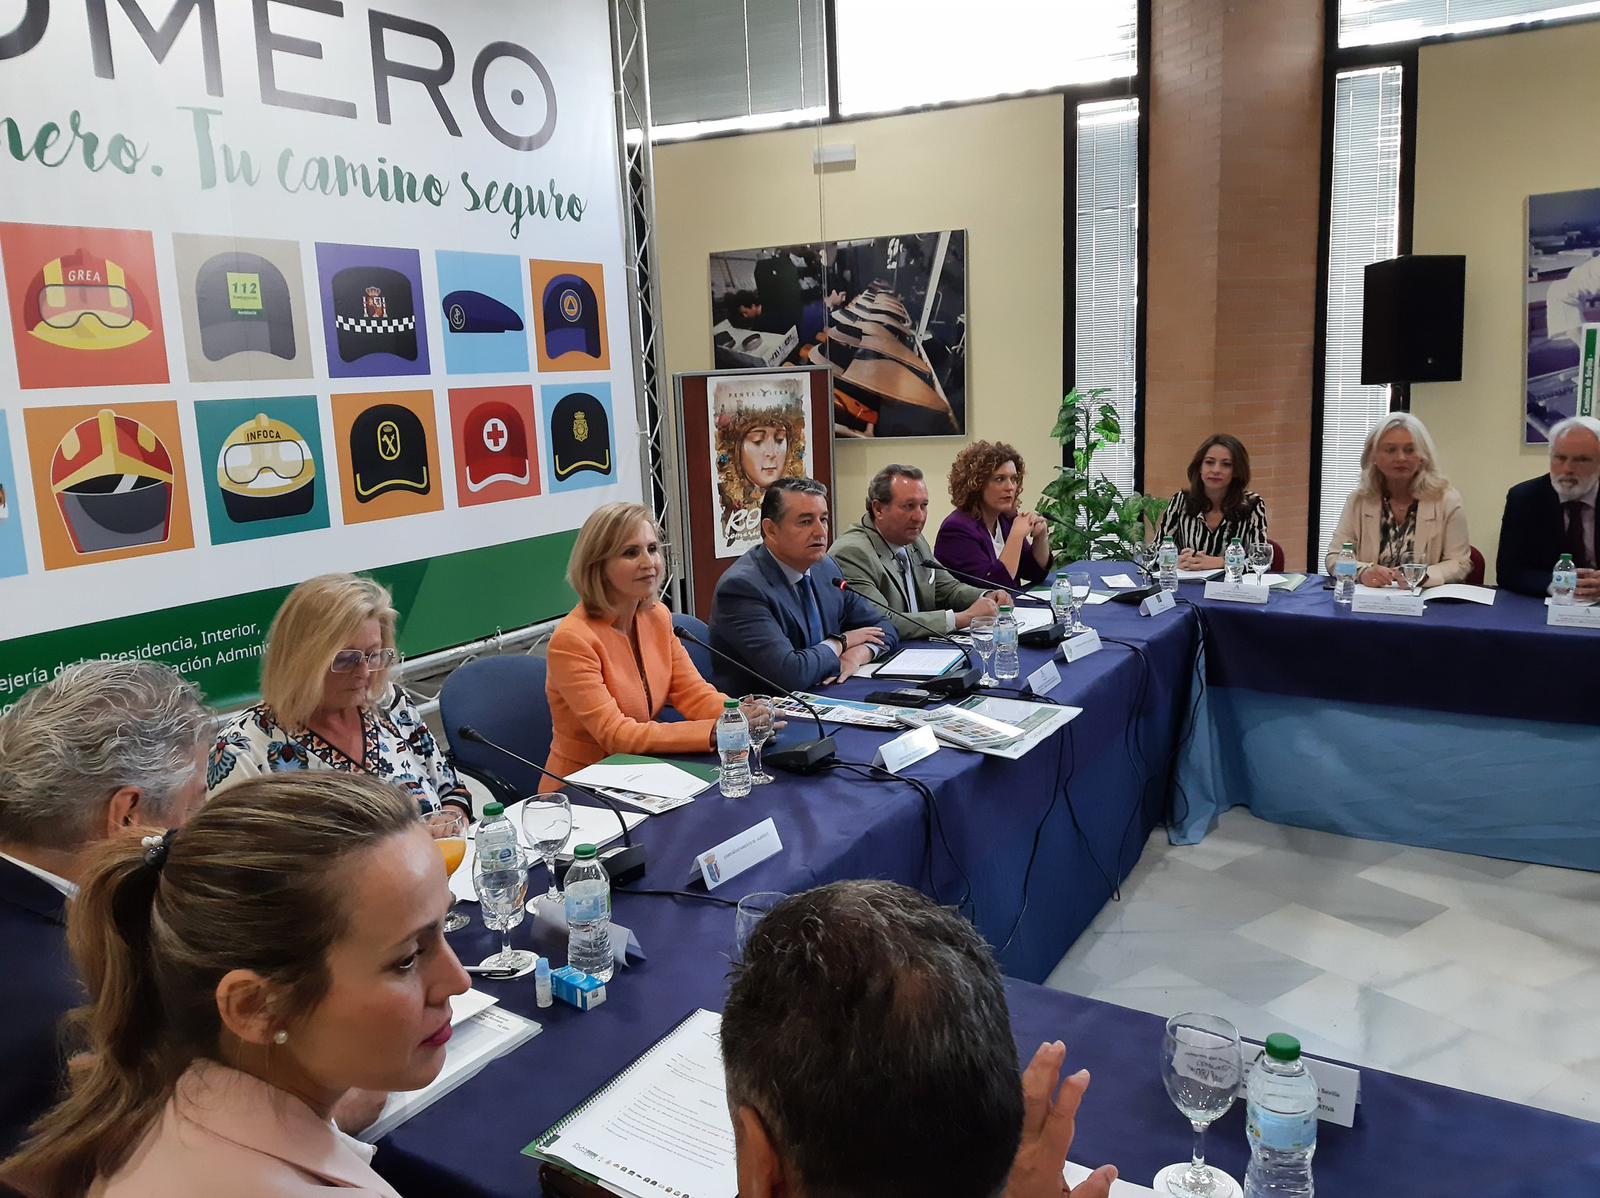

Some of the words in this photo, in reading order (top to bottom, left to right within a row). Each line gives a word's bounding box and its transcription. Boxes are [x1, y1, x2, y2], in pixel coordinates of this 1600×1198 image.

[0, 0, 557, 151] MERO
[176, 106, 261, 190] Tu
[277, 147, 449, 206] camino
[461, 171, 588, 239] seguro
[68, 269, 101, 283] GREA
[232, 282, 257, 294] 112
[246, 429, 282, 442] INFOCA
[201, 623, 261, 645] Interior,
